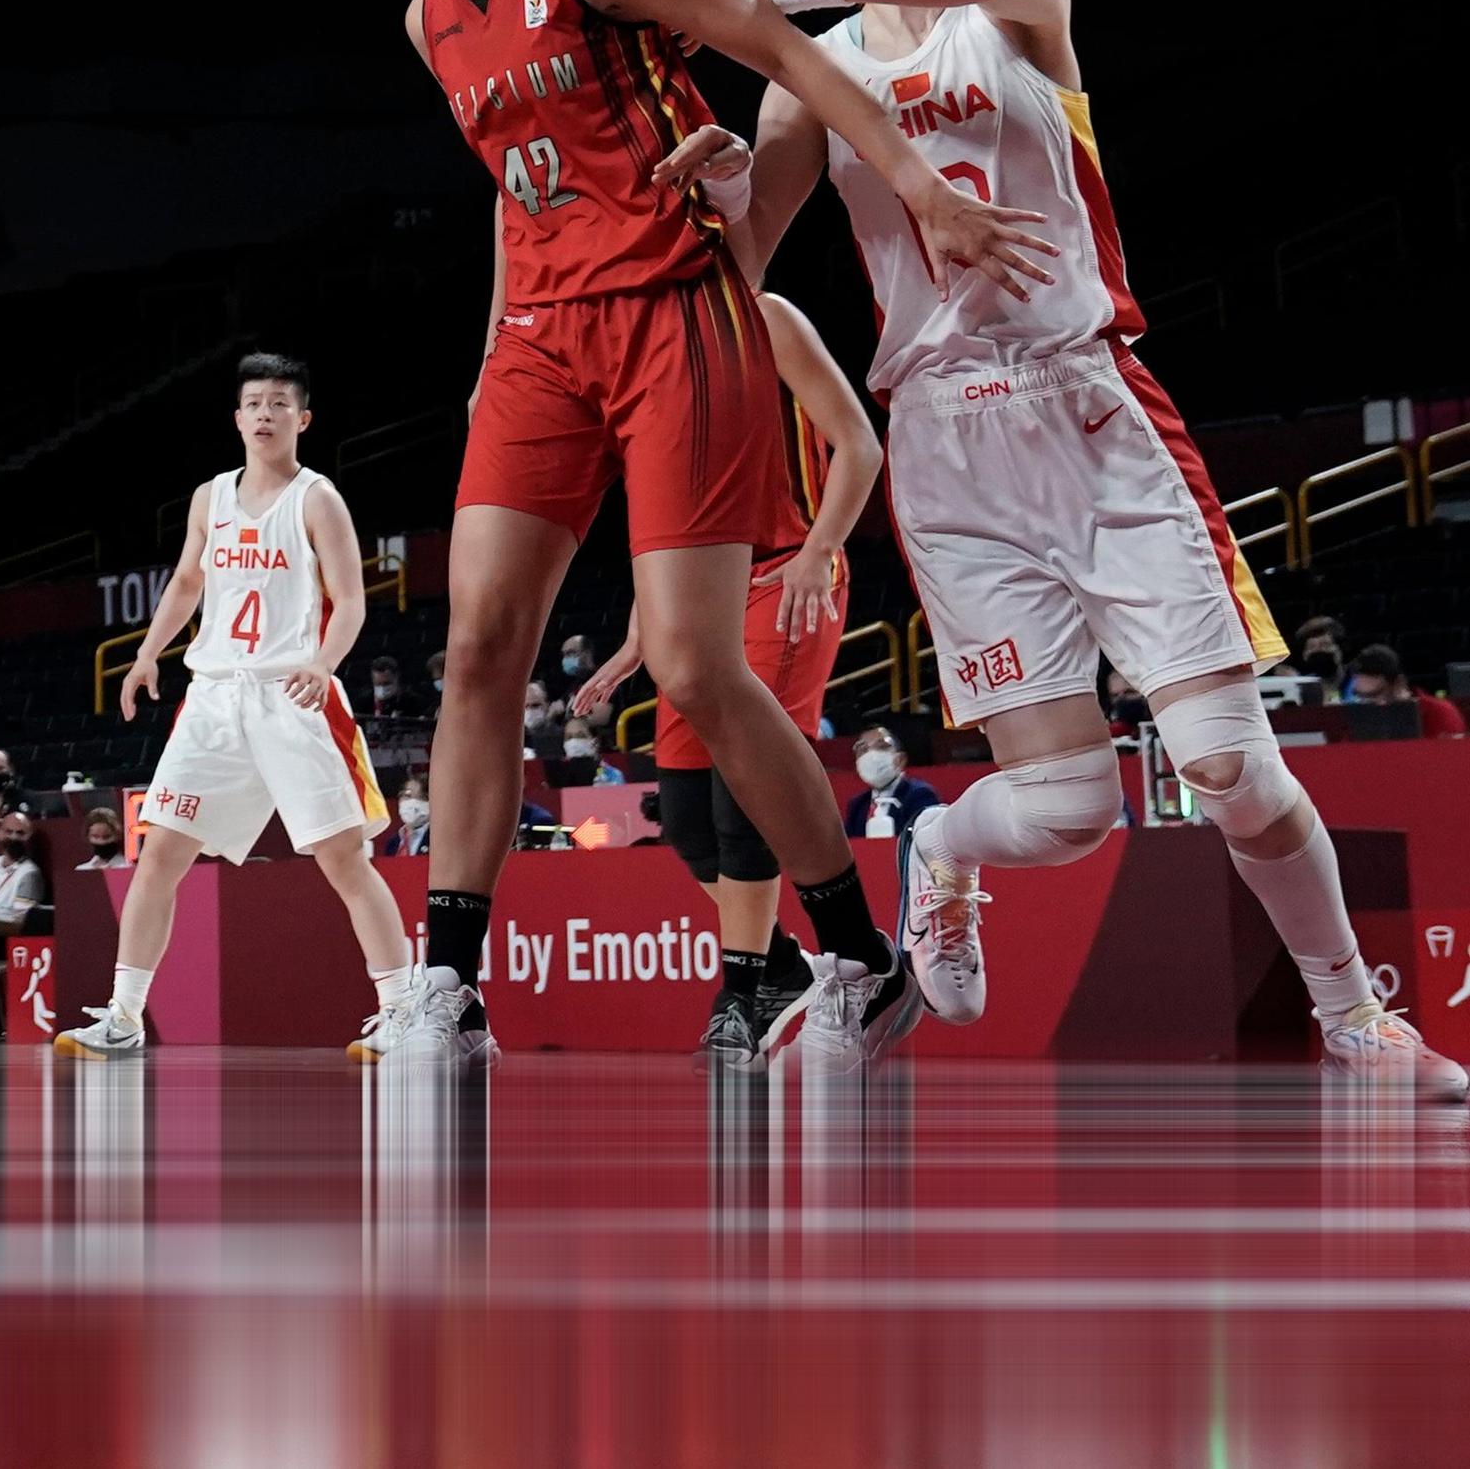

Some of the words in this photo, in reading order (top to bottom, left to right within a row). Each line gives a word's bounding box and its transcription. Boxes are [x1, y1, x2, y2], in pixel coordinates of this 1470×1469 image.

[450, 52, 580, 130] ELGIUM
[896, 83, 996, 139] HINA
[503, 137, 579, 217] 42
[964, 380, 1011, 400] CHN
[213, 548, 289, 569] CHINA
[97, 568, 173, 627] TOK
[230, 589, 261, 654] 4
[956, 638, 1024, 697] 中国
[156, 786, 201, 821] 中国
[507, 920, 553, 995] by
[567, 915, 719, 984] Emotio
